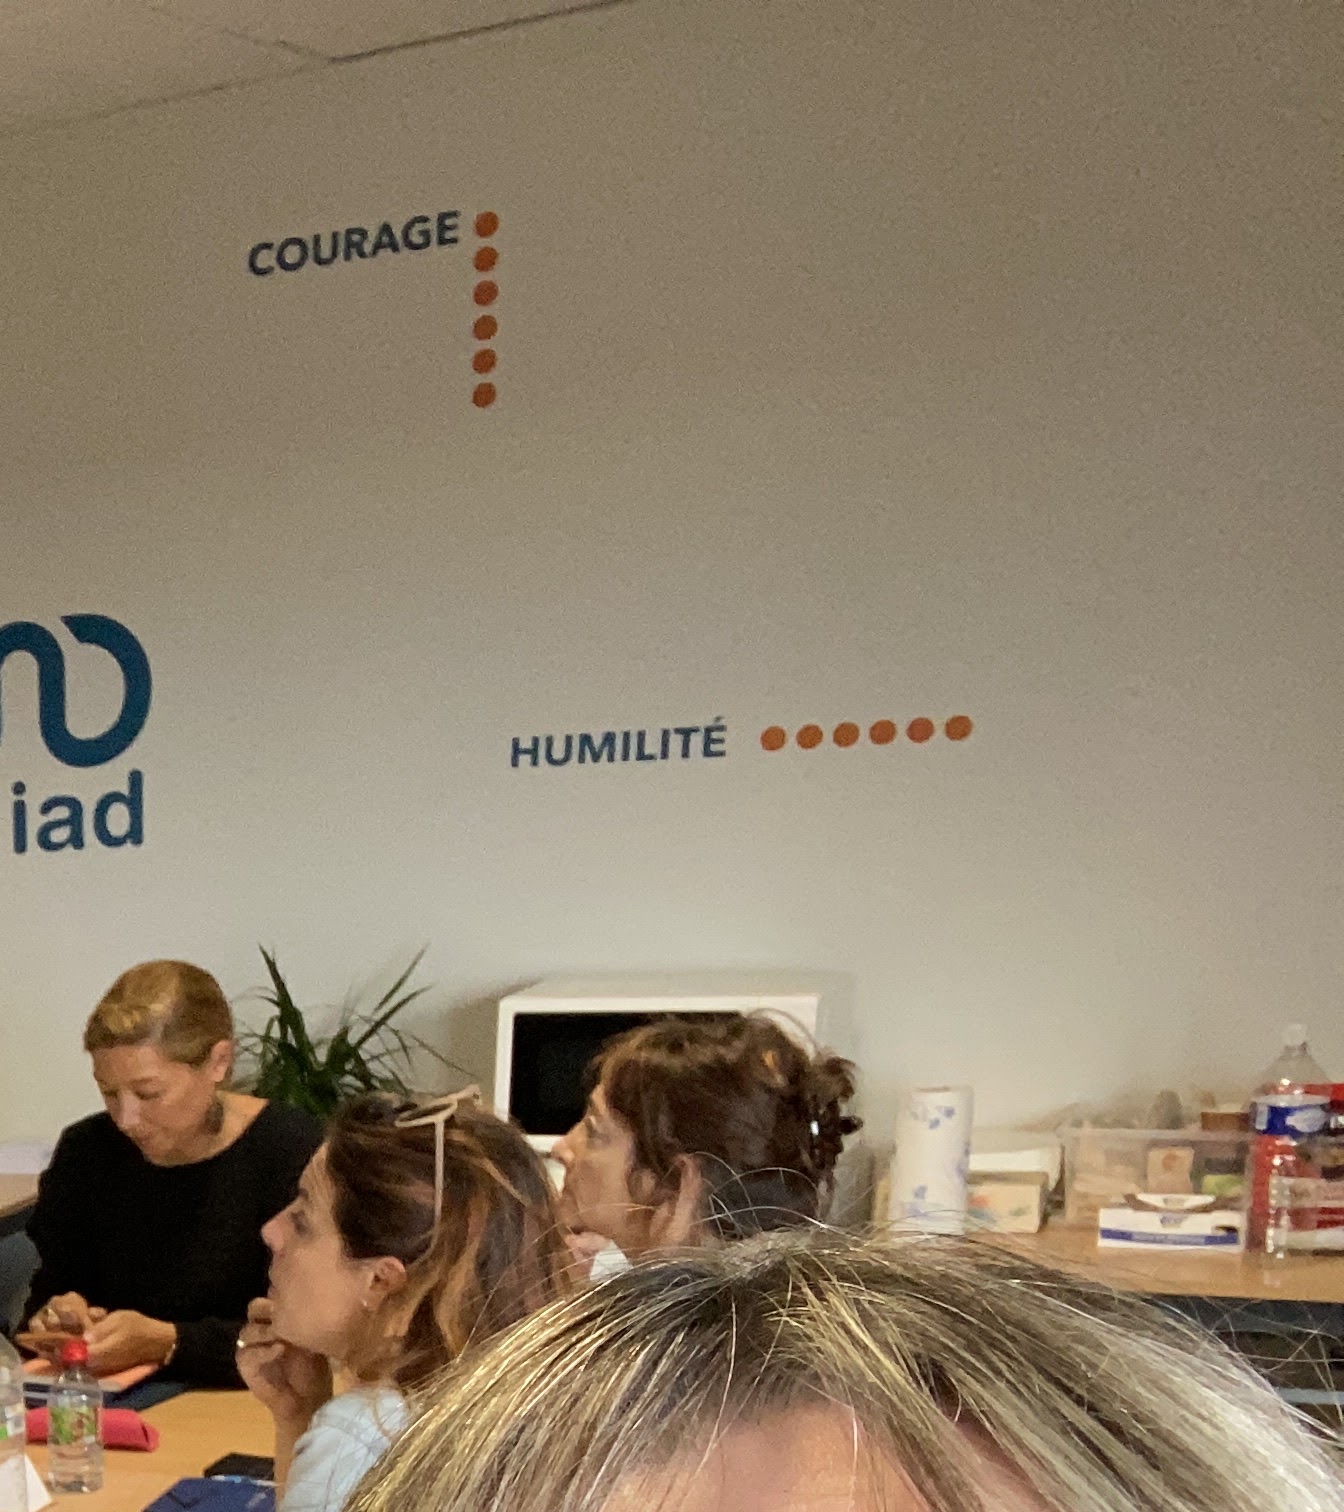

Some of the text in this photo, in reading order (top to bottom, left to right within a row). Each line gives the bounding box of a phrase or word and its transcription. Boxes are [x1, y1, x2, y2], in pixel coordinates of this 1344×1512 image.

[248, 210, 460, 278] COURAGE
[511, 716, 728, 769] HUMILITÉ
[12, 769, 144, 854] iad
